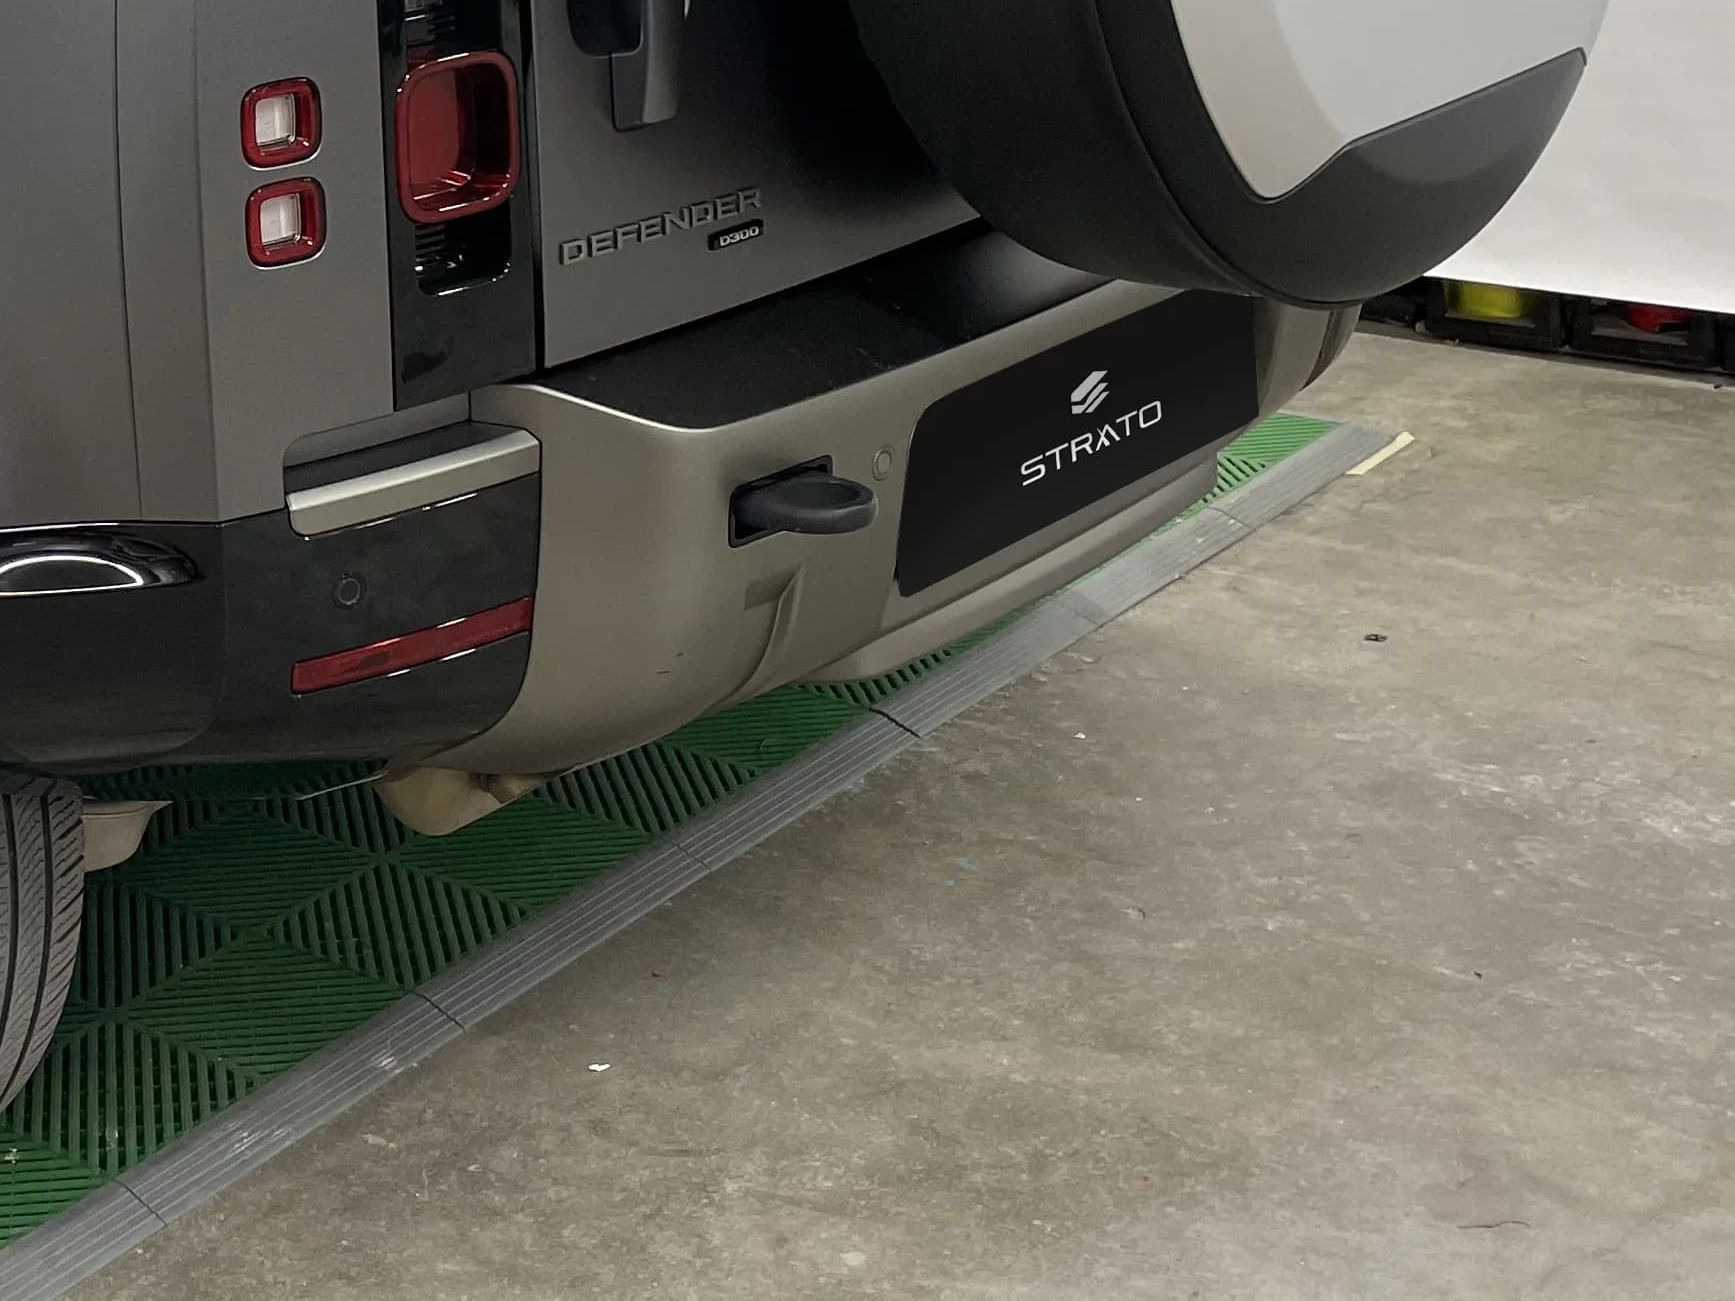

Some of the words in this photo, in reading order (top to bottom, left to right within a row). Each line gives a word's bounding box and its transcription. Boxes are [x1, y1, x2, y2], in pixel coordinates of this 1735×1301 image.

[558, 186, 763, 267] DEFENDER
[718, 225, 761, 247] D300
[1020, 399, 1163, 487] STRATO
